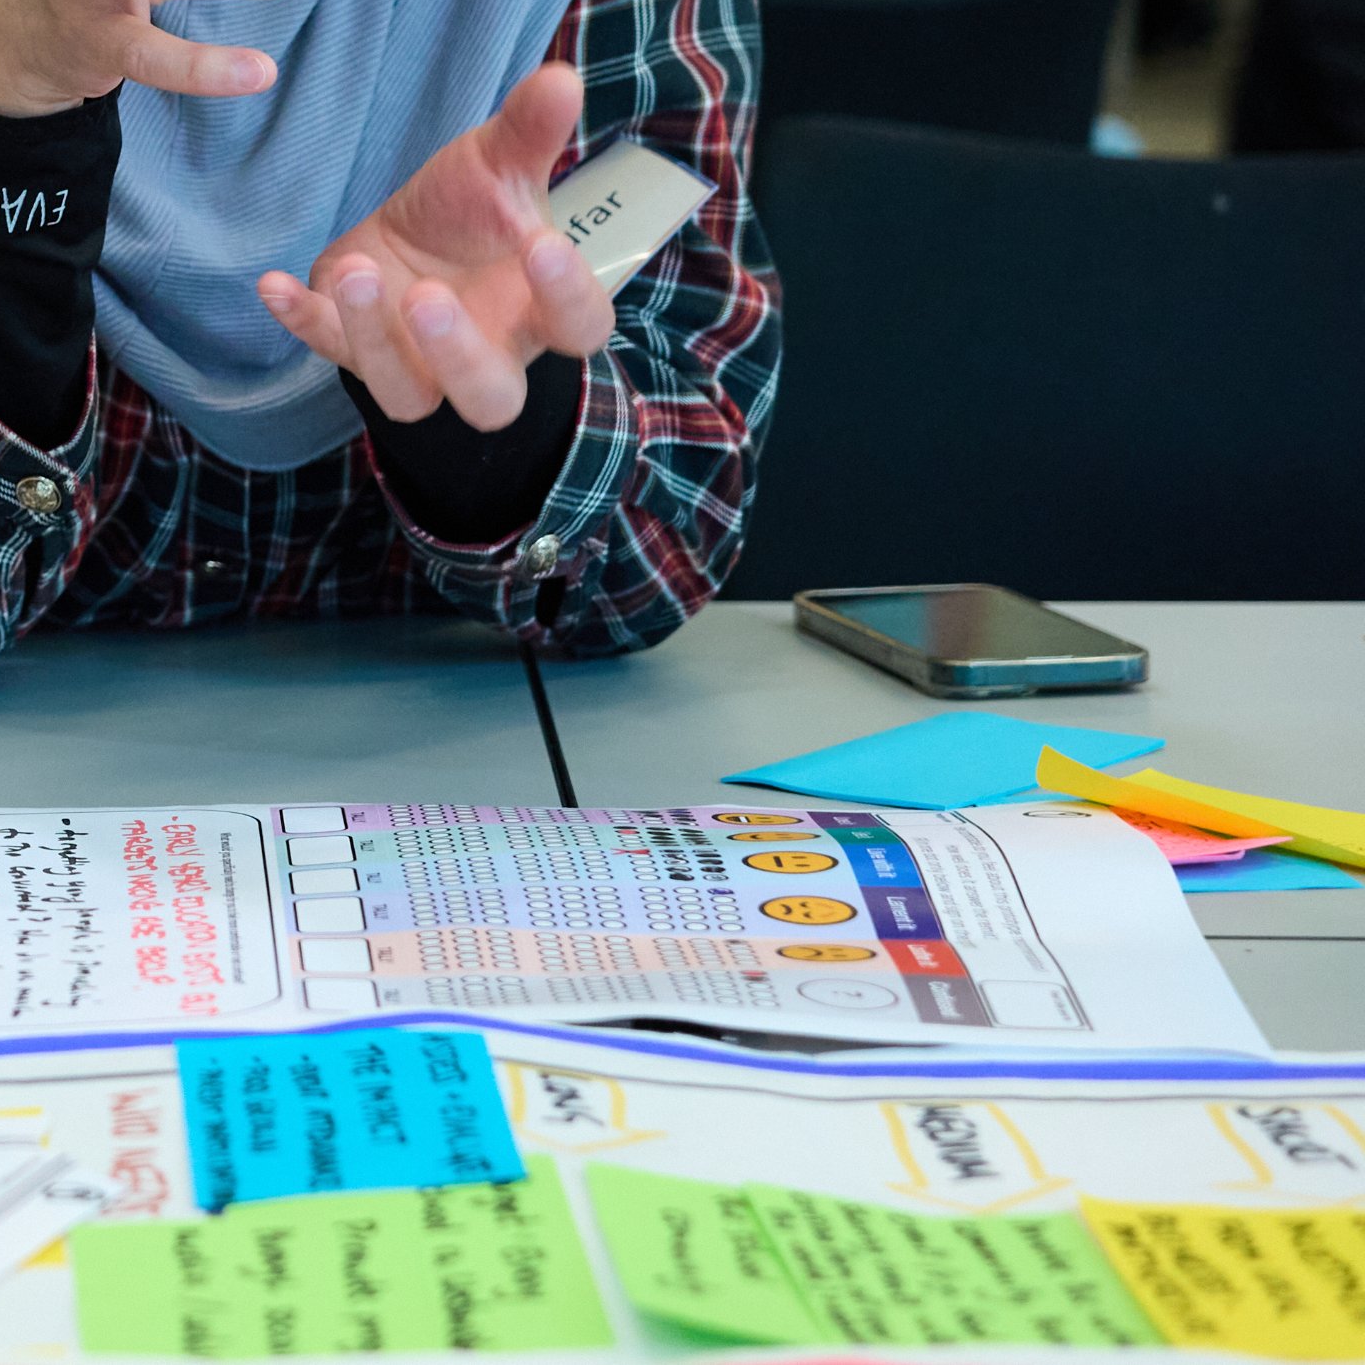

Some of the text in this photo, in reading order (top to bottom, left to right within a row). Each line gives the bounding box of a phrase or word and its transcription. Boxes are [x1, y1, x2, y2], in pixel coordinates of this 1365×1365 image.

[121, 820, 159, 872] TARGETS
[161, 824, 206, 857] EARLY
[167, 862, 212, 893] YEARS
